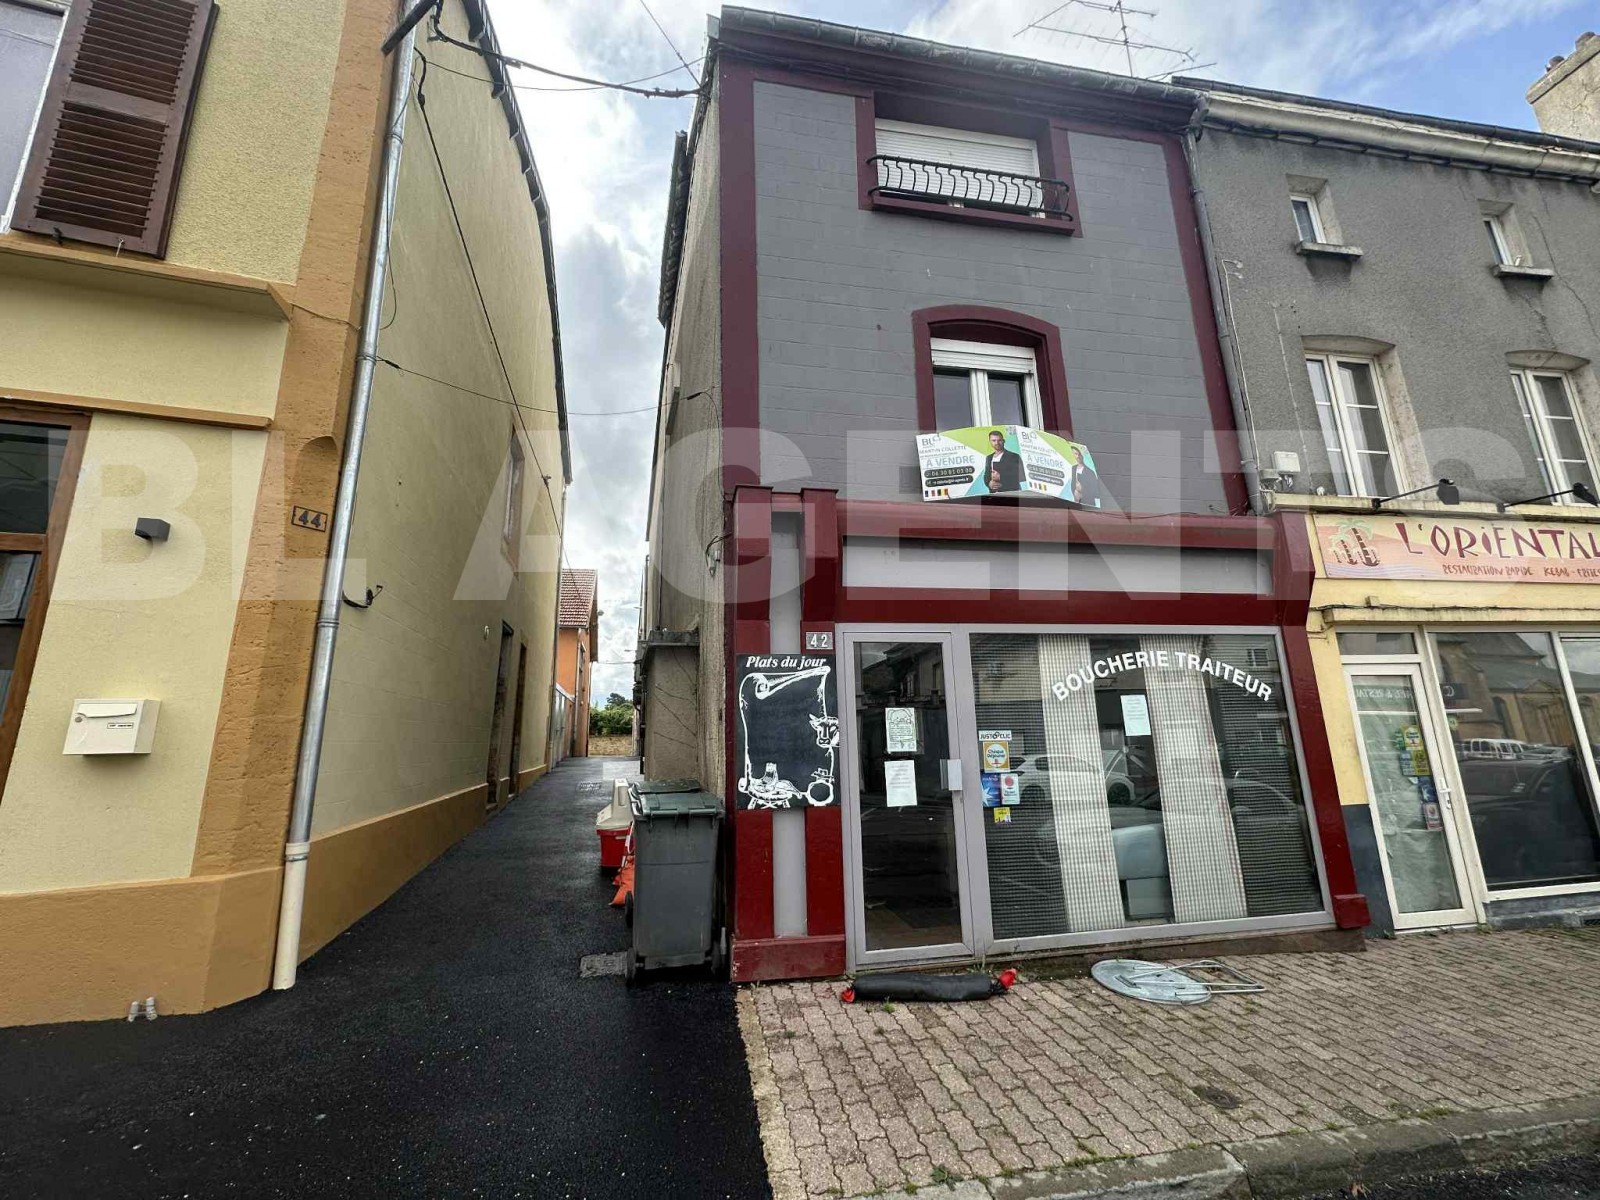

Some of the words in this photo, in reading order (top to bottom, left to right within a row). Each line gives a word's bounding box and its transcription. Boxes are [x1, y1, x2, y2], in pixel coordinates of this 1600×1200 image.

[935, 455, 976, 467] VENDRE
[1034, 455, 1064, 469] VENDRE
[298, 510, 321, 528] 44
[1544, 567, 1570, 577] KEBAB
[810, 633, 828, 648] 42
[746, 655, 778, 668] Plats
[780, 655, 797, 668] du
[797, 655, 827, 671] jour
[1051, 650, 1170, 702] BOUCHERIE
[1174, 651, 1273, 702] TRAITEUR
